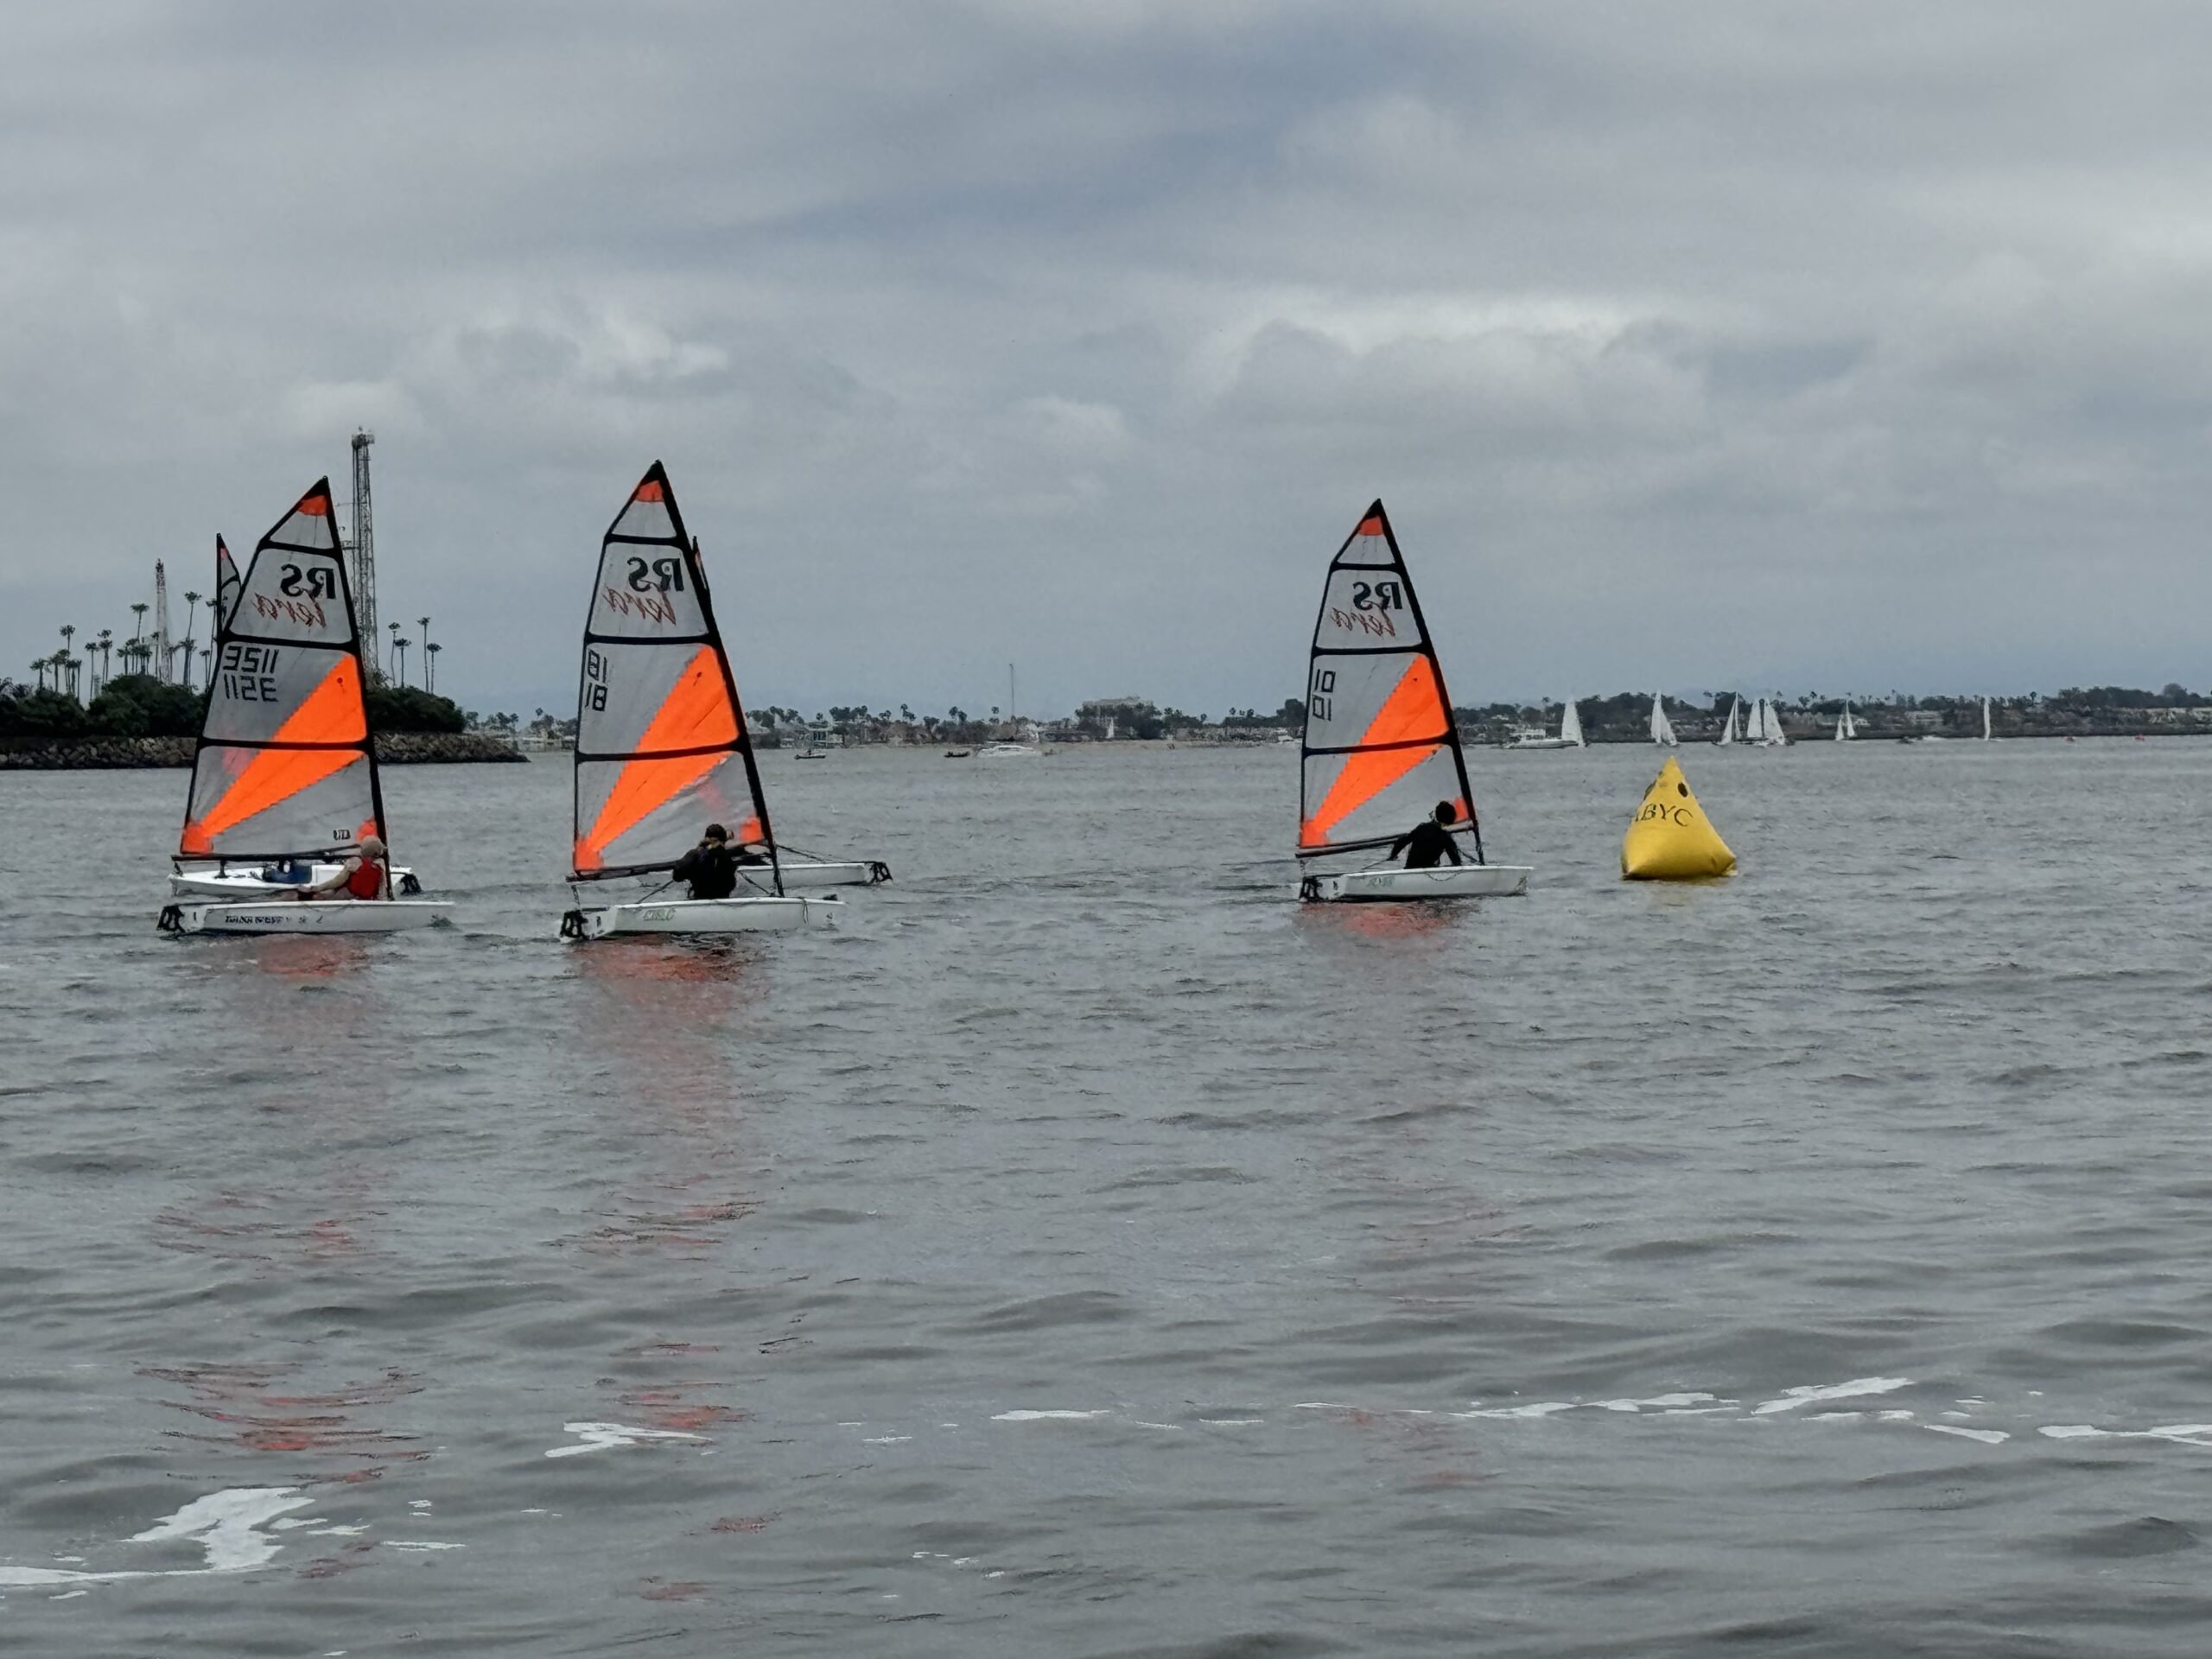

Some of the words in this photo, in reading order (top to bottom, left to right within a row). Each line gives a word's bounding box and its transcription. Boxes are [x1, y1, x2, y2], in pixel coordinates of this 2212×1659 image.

[223, 645, 279, 674] 3511
[1314, 669, 1336, 693] 10
[585, 683, 607, 712] 18
